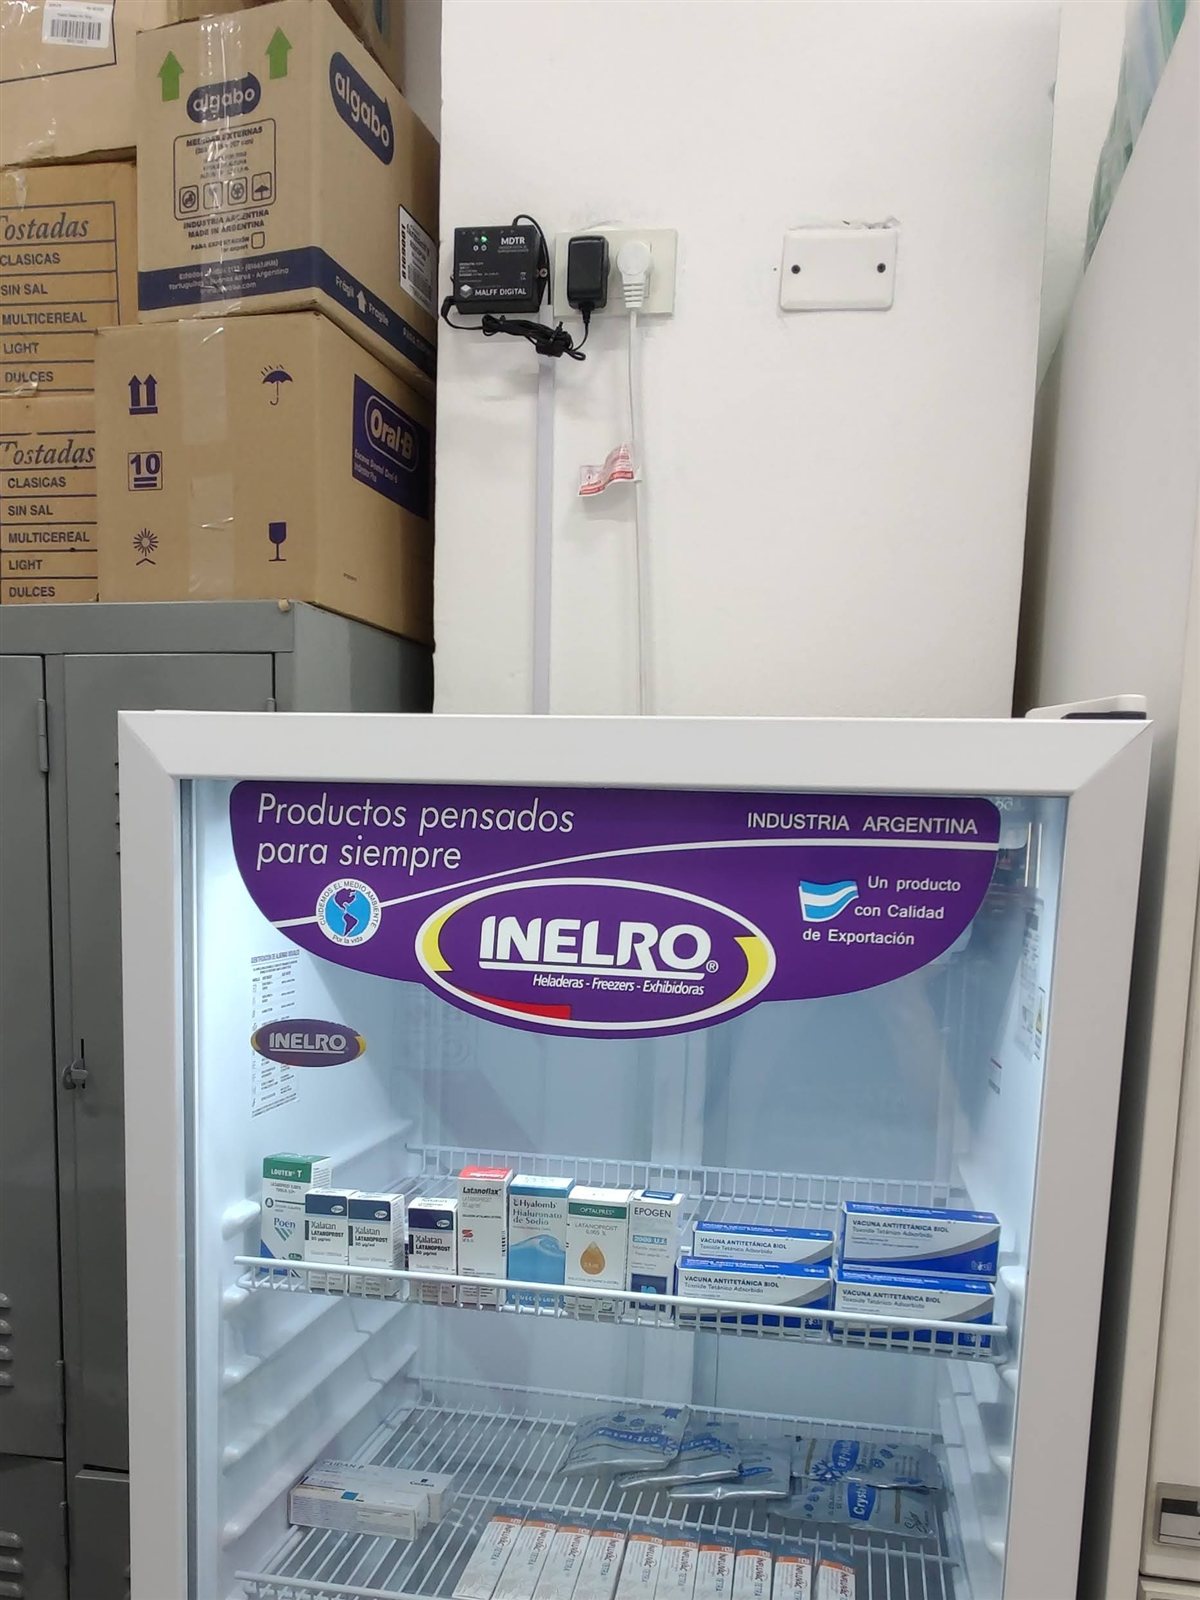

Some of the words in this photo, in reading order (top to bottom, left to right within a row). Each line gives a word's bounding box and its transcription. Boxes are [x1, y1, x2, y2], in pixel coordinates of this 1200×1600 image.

[192, 88, 255, 113] algabo
[335, 72, 390, 147] algabo
[0, 212, 89, 240] ostadas
[501, 236, 526, 245] MDTR
[0, 252, 61, 266] CLASICAS
[0, 284, 20, 296] SIN
[24, 283, 48, 295] SAL
[475, 288, 498, 296] MALFF
[500, 287, 527, 296] DIGITAL
[2, 312, 87, 325] MULTICEREAL
[3, 343, 39, 354] LIGHT
[5, 371, 54, 383] DULCES
[370, 408, 413, 460] Oral-B
[130, 453, 161, 475] 10
[8, 476, 66, 489] CLASICAS
[8, 505, 27, 516] SIN
[30, 504, 53, 516] SAL
[8, 531, 90, 544] MULTICEREAL
[8, 559, 43, 571] LIGHT
[9, 586, 55, 598] DULCES
[258, 792, 407, 827] Productos
[418, 797, 575, 837] pensados
[747, 812, 850, 832] INDUSTRIA
[862, 816, 978, 835] ARGENTINA
[256, 842, 329, 872] para
[339, 834, 462, 876] siempre
[867, 876, 888, 889] Un
[896, 878, 961, 892] producto
[318, 887, 334, 926] CUIDEMOS
[333, 882, 343, 890] EL
[344, 881, 367, 892] MEDIO
[365, 891, 380, 929] AMBIENTE
[854, 905, 881, 917] con
[887, 904, 945, 919] Calidad
[802, 928, 821, 941] de
[828, 929, 915, 945] Exportación
[533, 974, 584, 989] Heladeras
[592, 977, 635, 992] Freezers
[643, 980, 705, 996] Exhibidoras
[269, 1032, 347, 1052] INELRO
[634, 1207, 672, 1218] EPOGEN
[274, 1218, 296, 1228] Poen
[311, 1221, 336, 1230] Xalatan
[513, 1216, 524, 1224] de
[526, 1217, 549, 1226] Sodio
[853, 1219, 880, 1228] VACUNA
[882, 1222, 932, 1231] ANTITETÁNICA
[933, 1225, 949, 1233] BIOL
[355, 1226, 380, 1236] Xalatan
[415, 1235, 443, 1244] Xalatan
[700, 1237, 725, 1245] VACUNA
[727, 1239, 772, 1249] ANTITETÁNICA
[685, 1275, 711, 1284] VACUNA
[714, 1278, 763, 1287] ANTITETÁNICA
[764, 1281, 779, 1289] BIOL
[842, 1289, 870, 1298] VACUNA
[873, 1291, 923, 1302] ANTITETÁNICA
